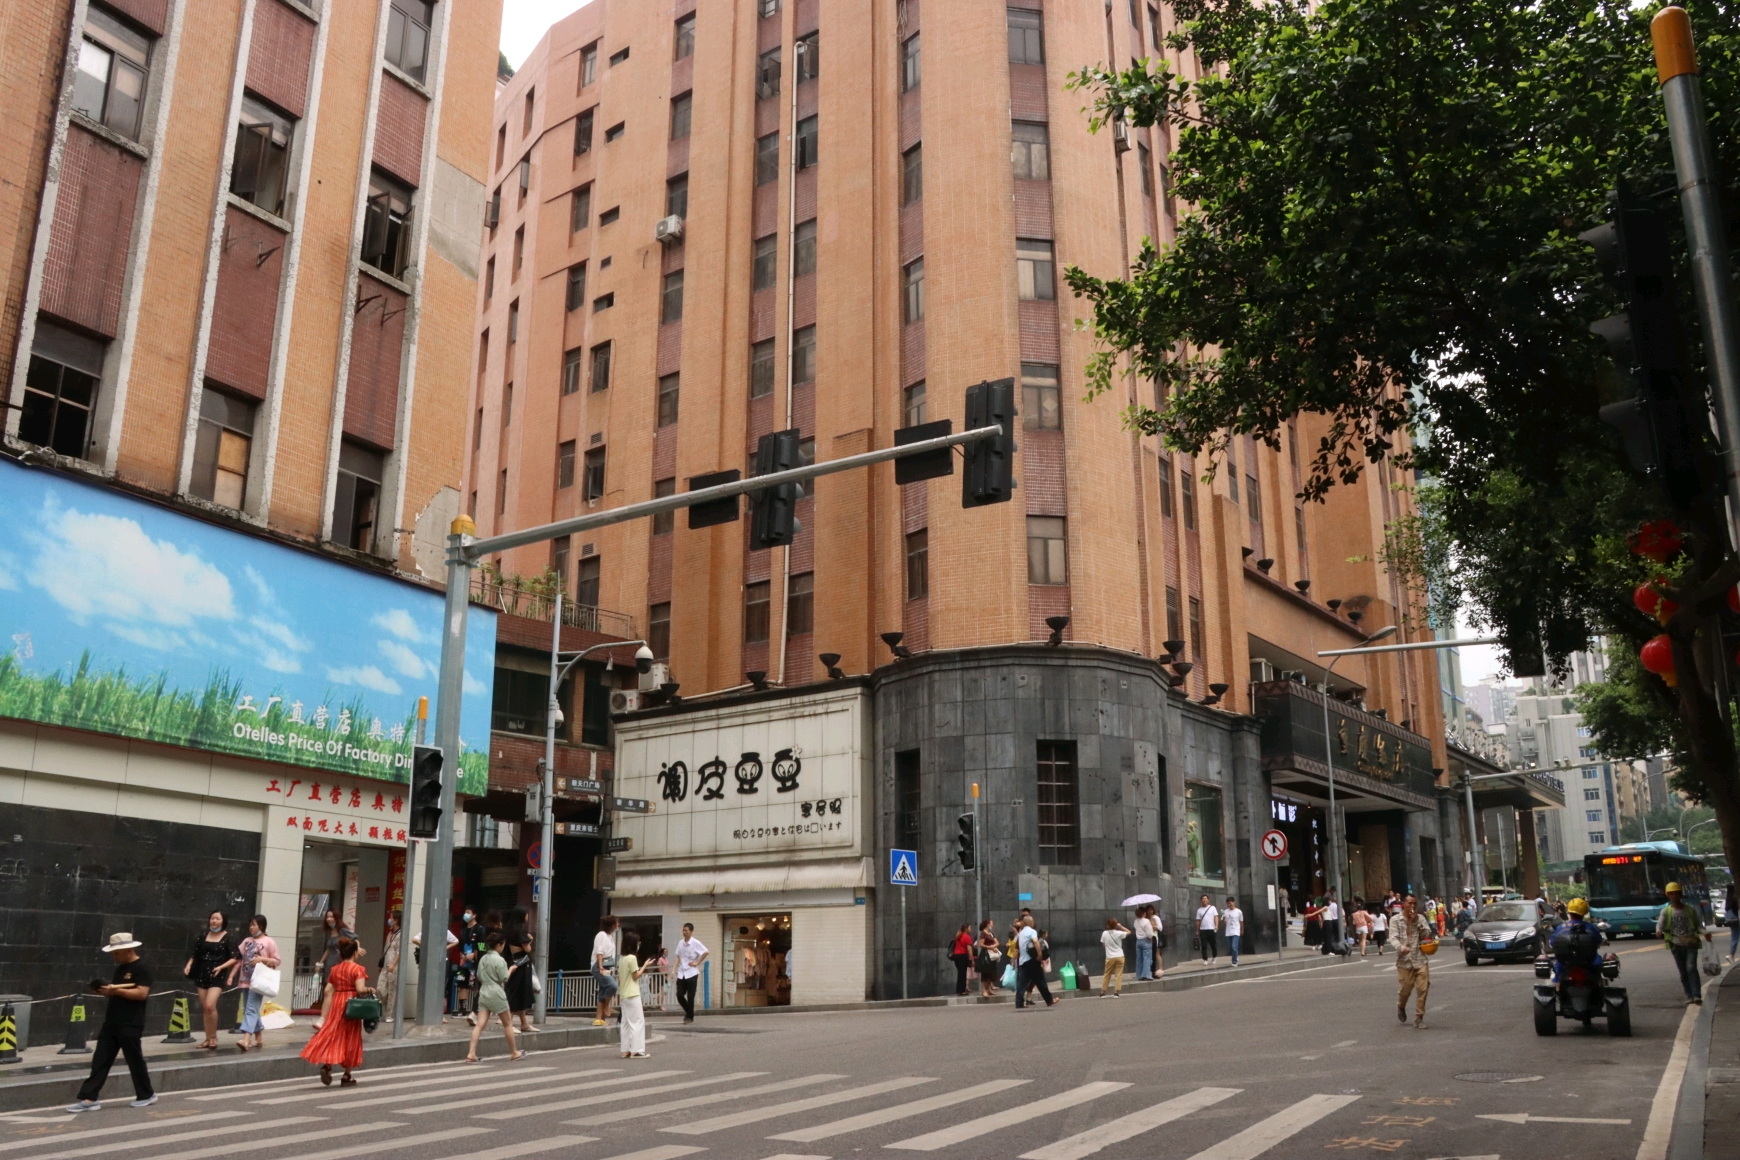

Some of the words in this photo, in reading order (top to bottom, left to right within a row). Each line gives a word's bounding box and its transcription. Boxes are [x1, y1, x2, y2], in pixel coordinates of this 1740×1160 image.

[237, 695, 352, 736] 工厂直营店
[233, 722, 285, 746] Otelles
[288, 732, 323, 753] Price
[326, 740, 343, 757] Of
[345, 743, 393, 769] Factory
[266, 779, 361, 808] 工厂直营店
[286, 816, 359, 836] 双面呢大衣
